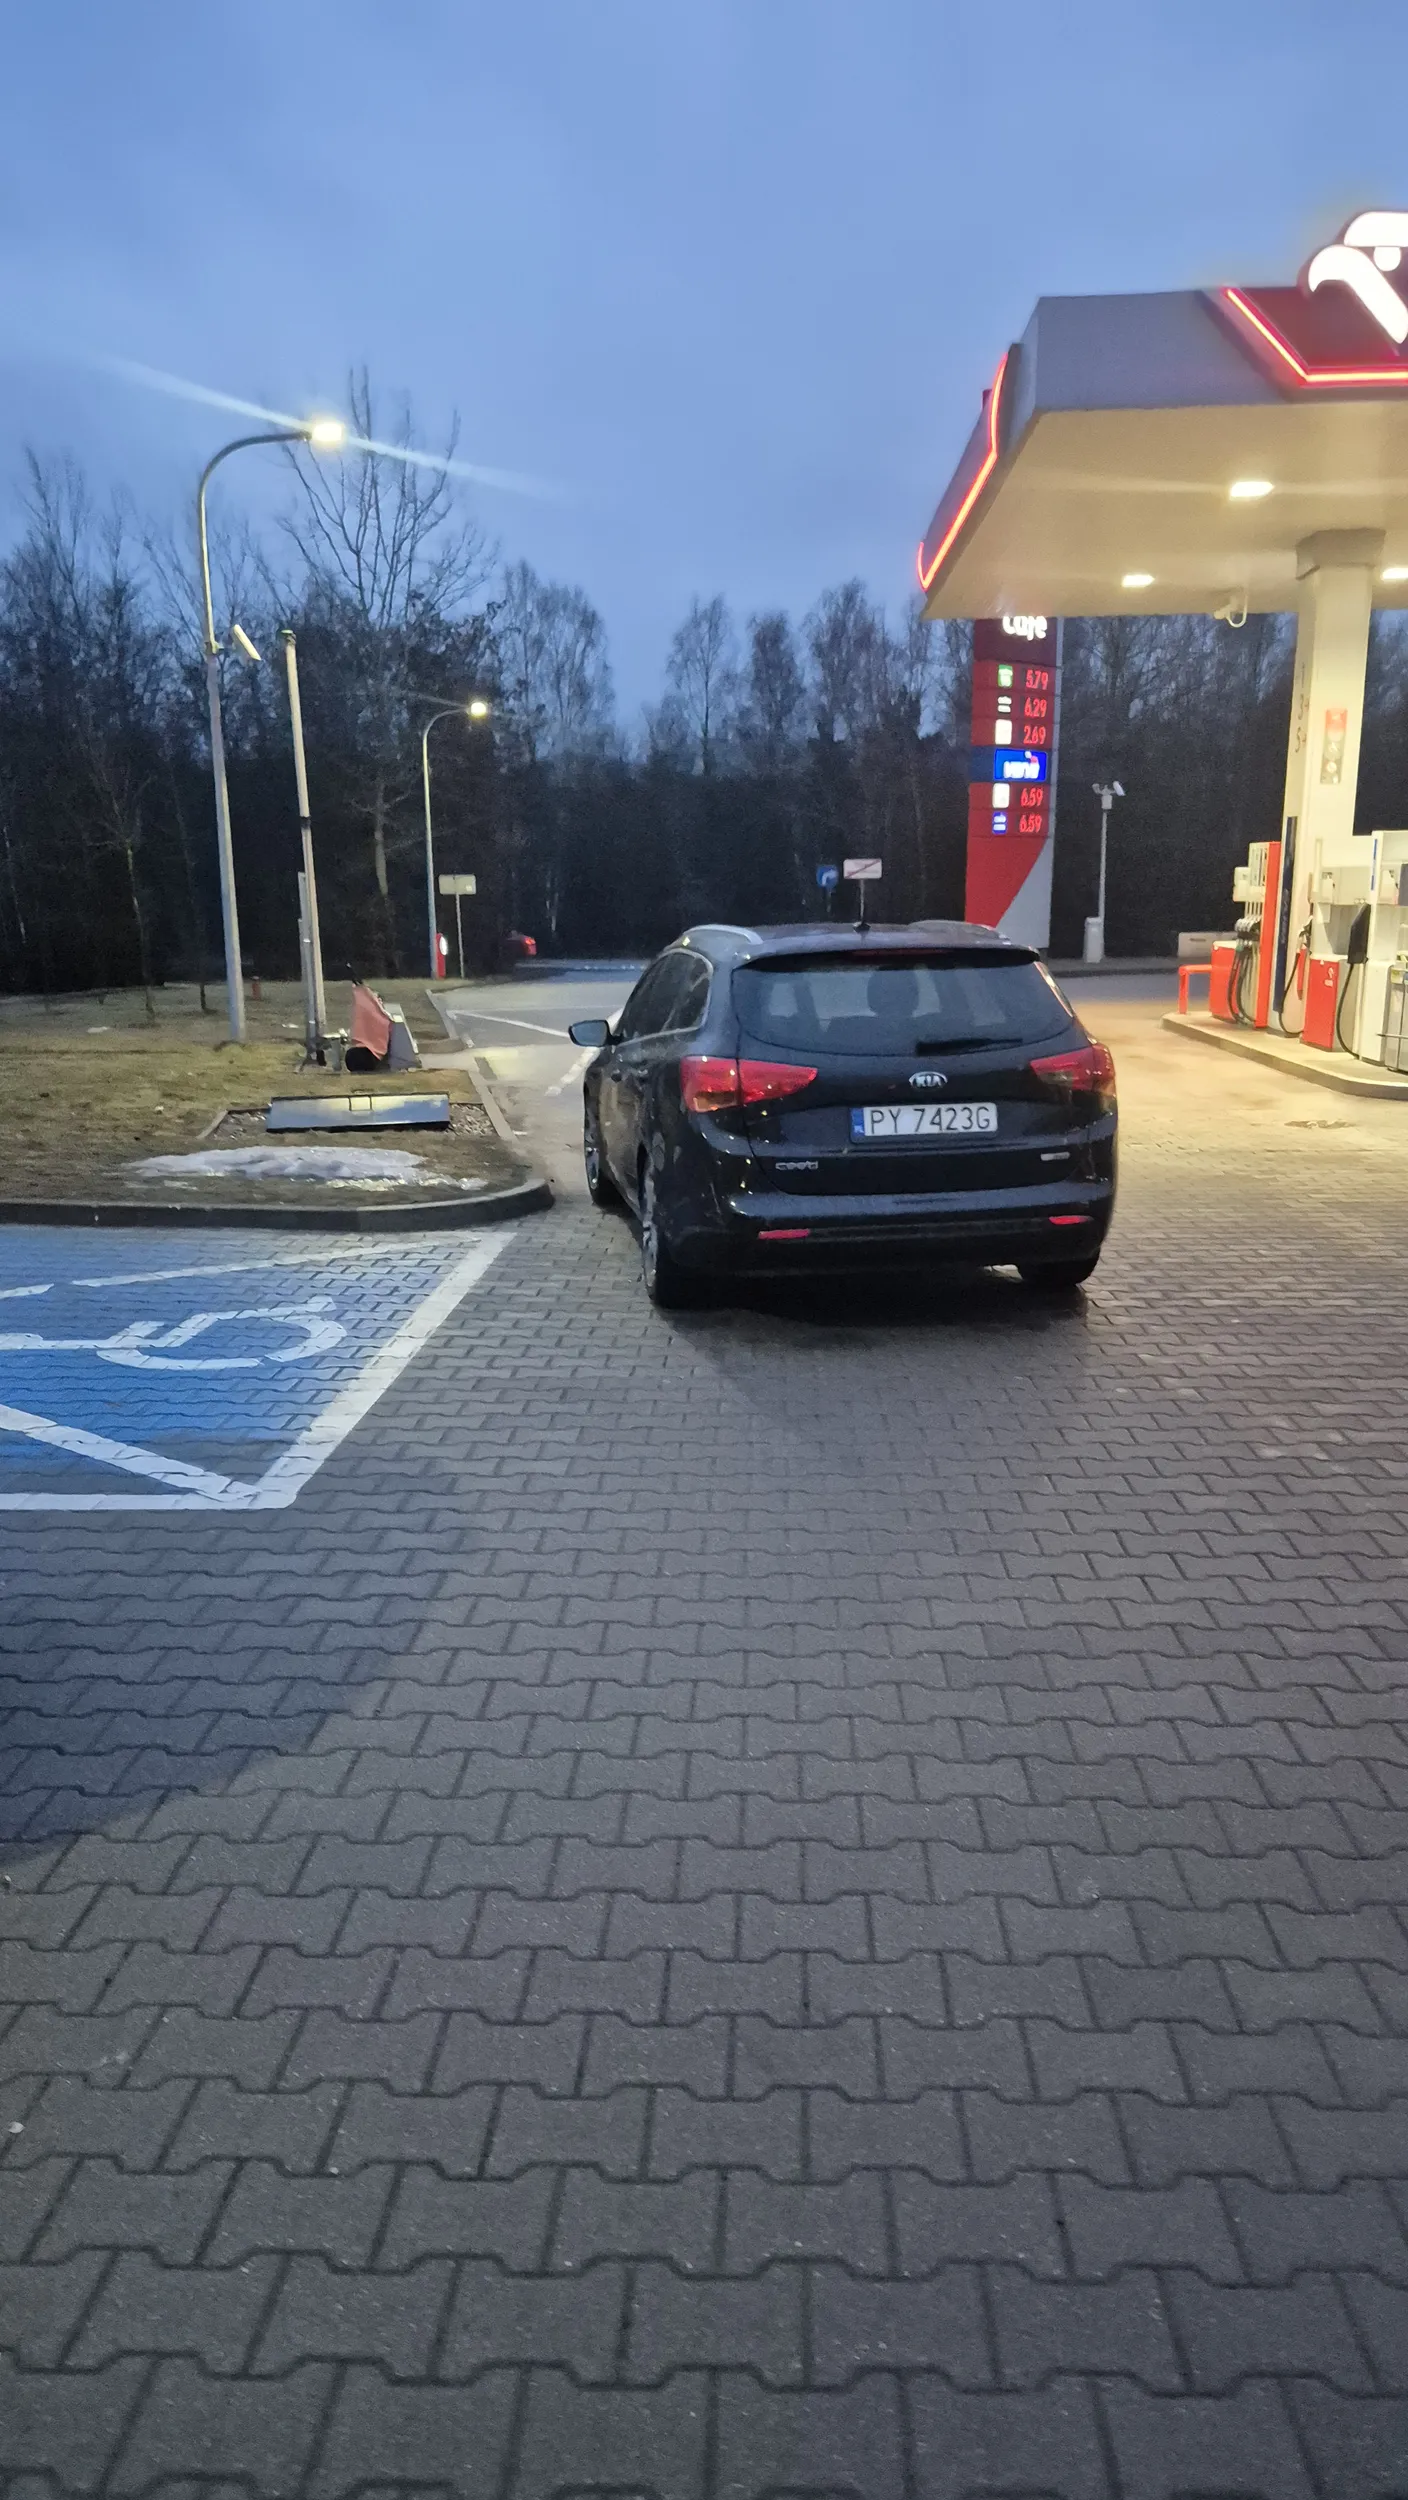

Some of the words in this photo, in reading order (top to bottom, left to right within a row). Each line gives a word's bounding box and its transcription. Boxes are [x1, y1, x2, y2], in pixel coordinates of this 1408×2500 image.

[1025, 669, 1049, 691] 5.79
[1024, 697, 1048, 718] 6.29
[1023, 725, 1047, 745] 2.69
[1020, 787, 1044, 808] 6.59
[1019, 813, 1043, 834] 6.59
[913, 1073, 944, 1088] KIA
[870, 1108, 902, 1134] PY
[913, 1106, 990, 1132] 7423G
